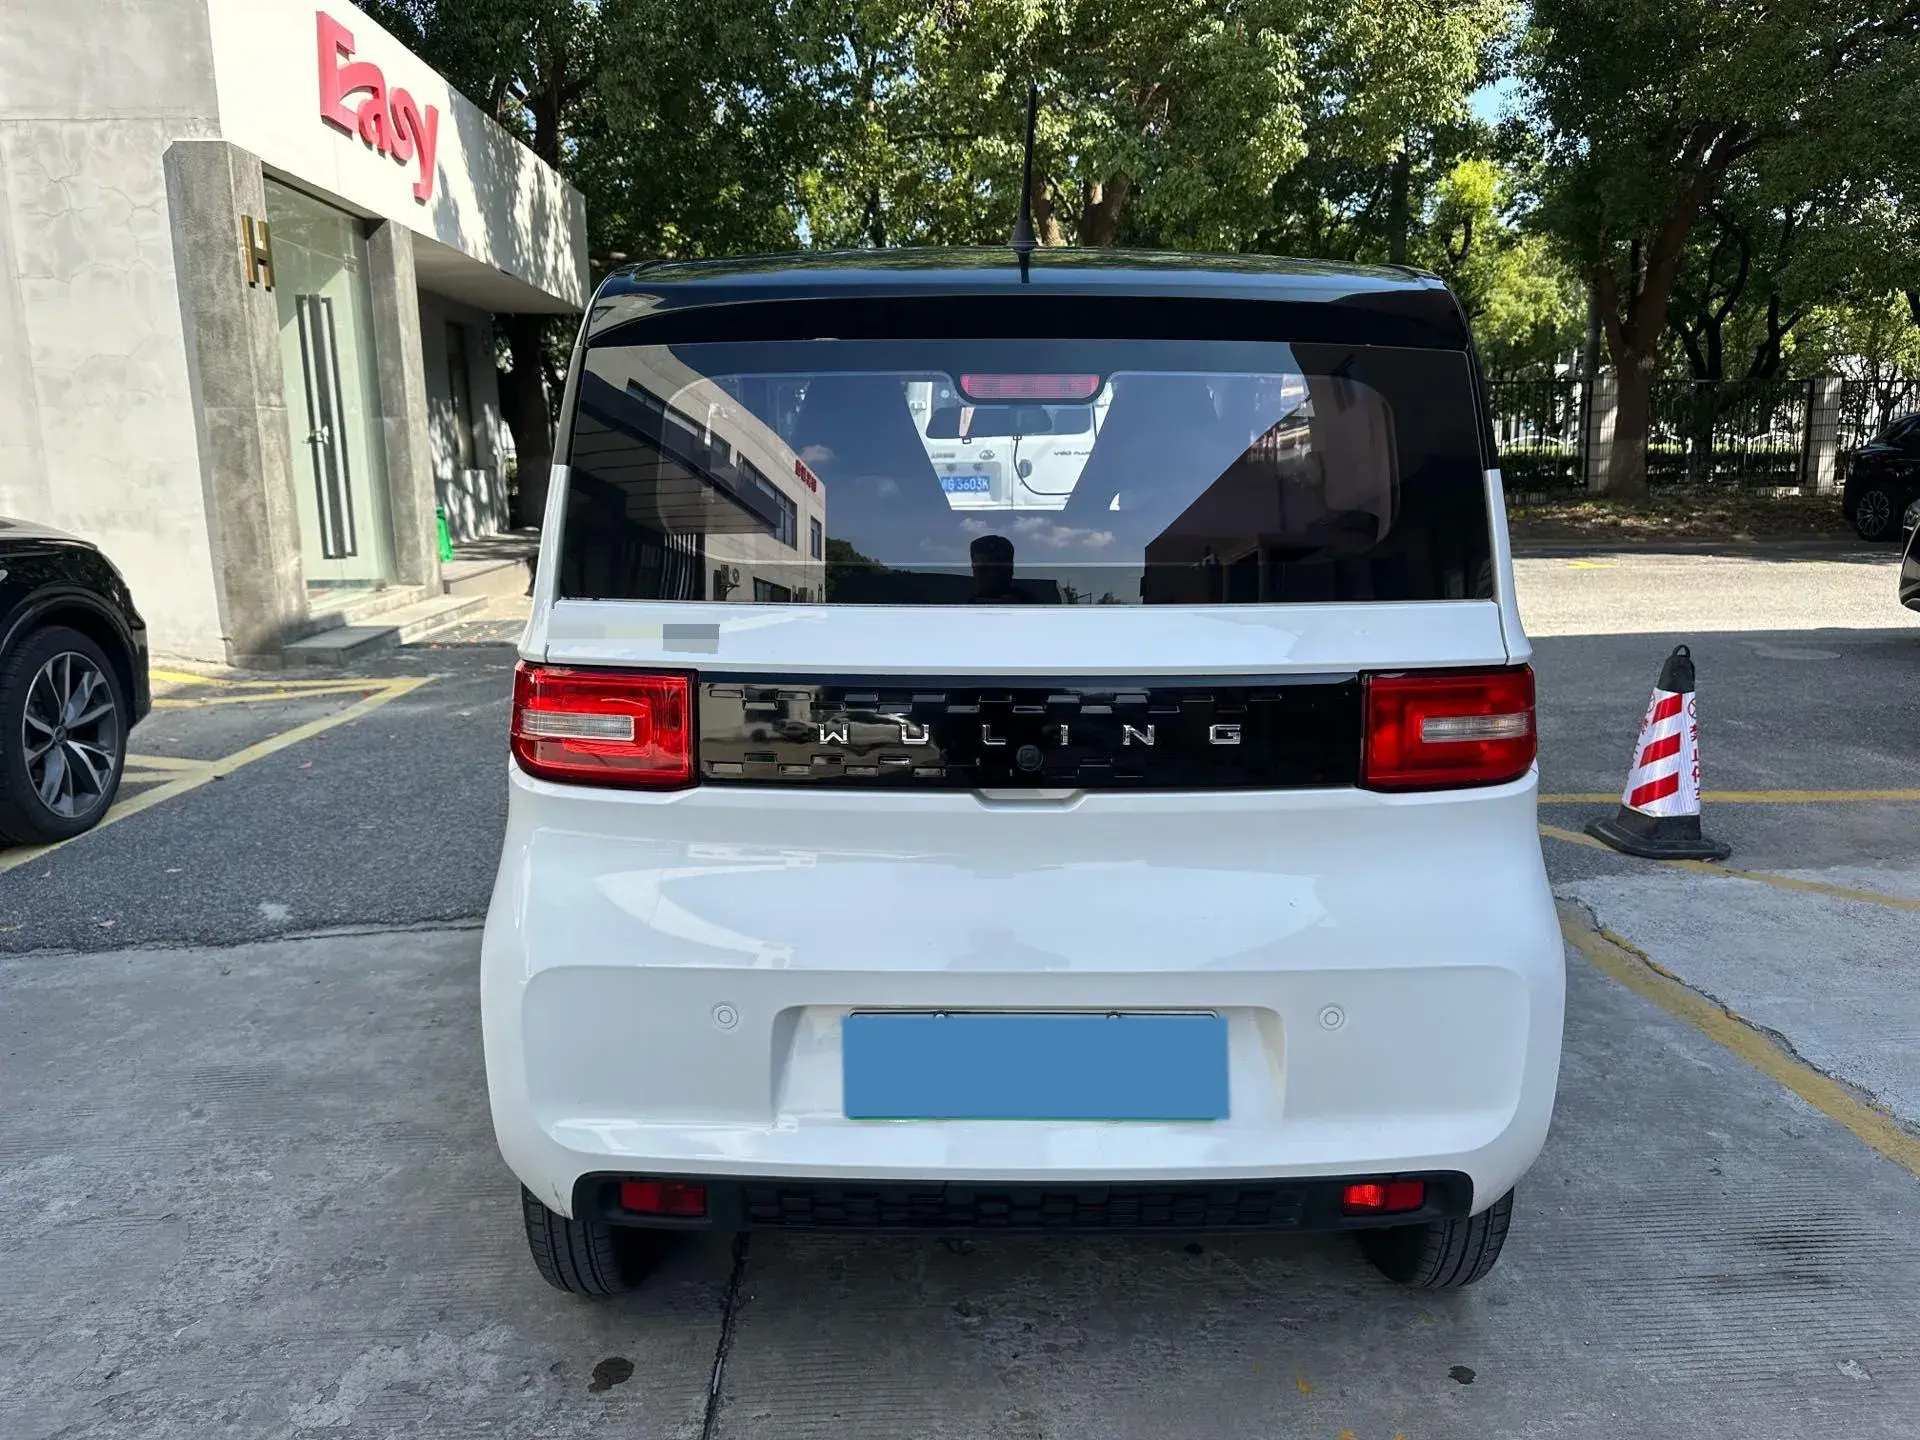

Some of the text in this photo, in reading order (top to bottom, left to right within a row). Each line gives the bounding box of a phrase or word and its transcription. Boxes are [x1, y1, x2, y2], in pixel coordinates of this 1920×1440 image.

[316, 11, 439, 203] Easy
[241, 214, 275, 292] H
[818, 723, 1243, 745] WULING
